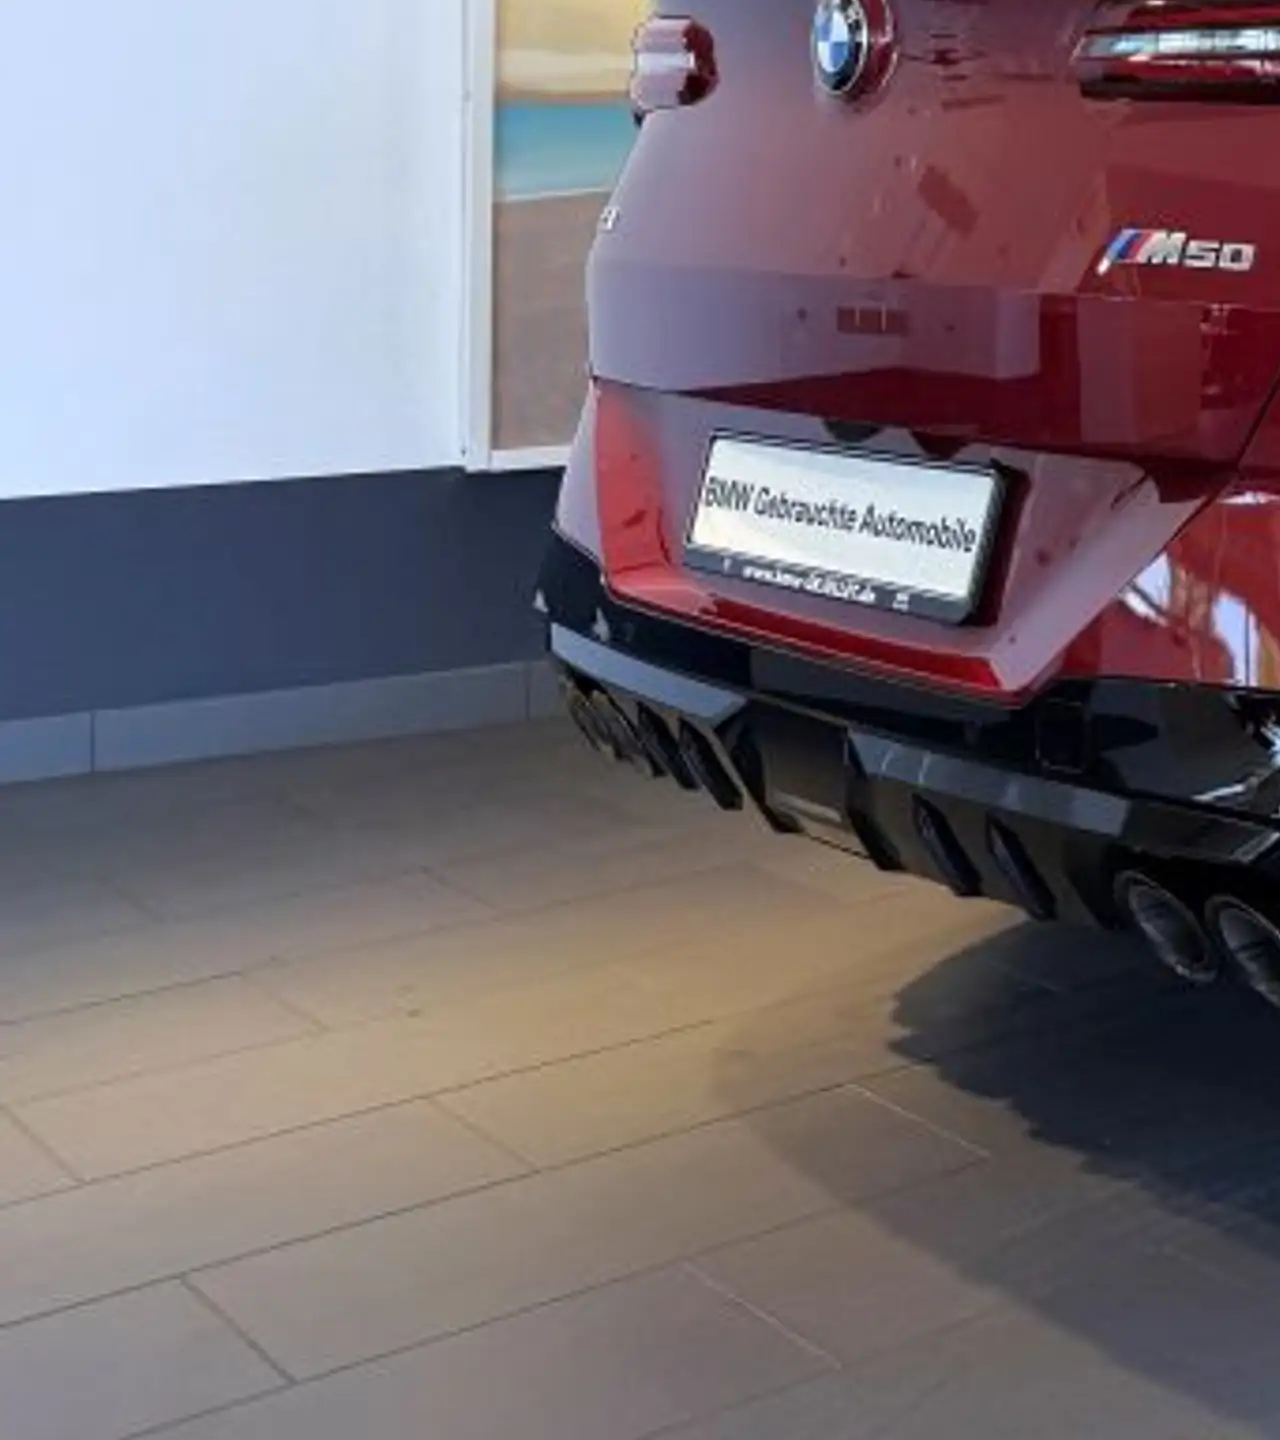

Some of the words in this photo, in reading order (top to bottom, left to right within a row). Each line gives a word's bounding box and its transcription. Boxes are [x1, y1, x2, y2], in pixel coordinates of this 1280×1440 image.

[1116, 227, 1256, 273] M50
[704, 476, 754, 512] BMW
[754, 486, 857, 533] Gebrauchte
[858, 503, 977, 553] Automobile
